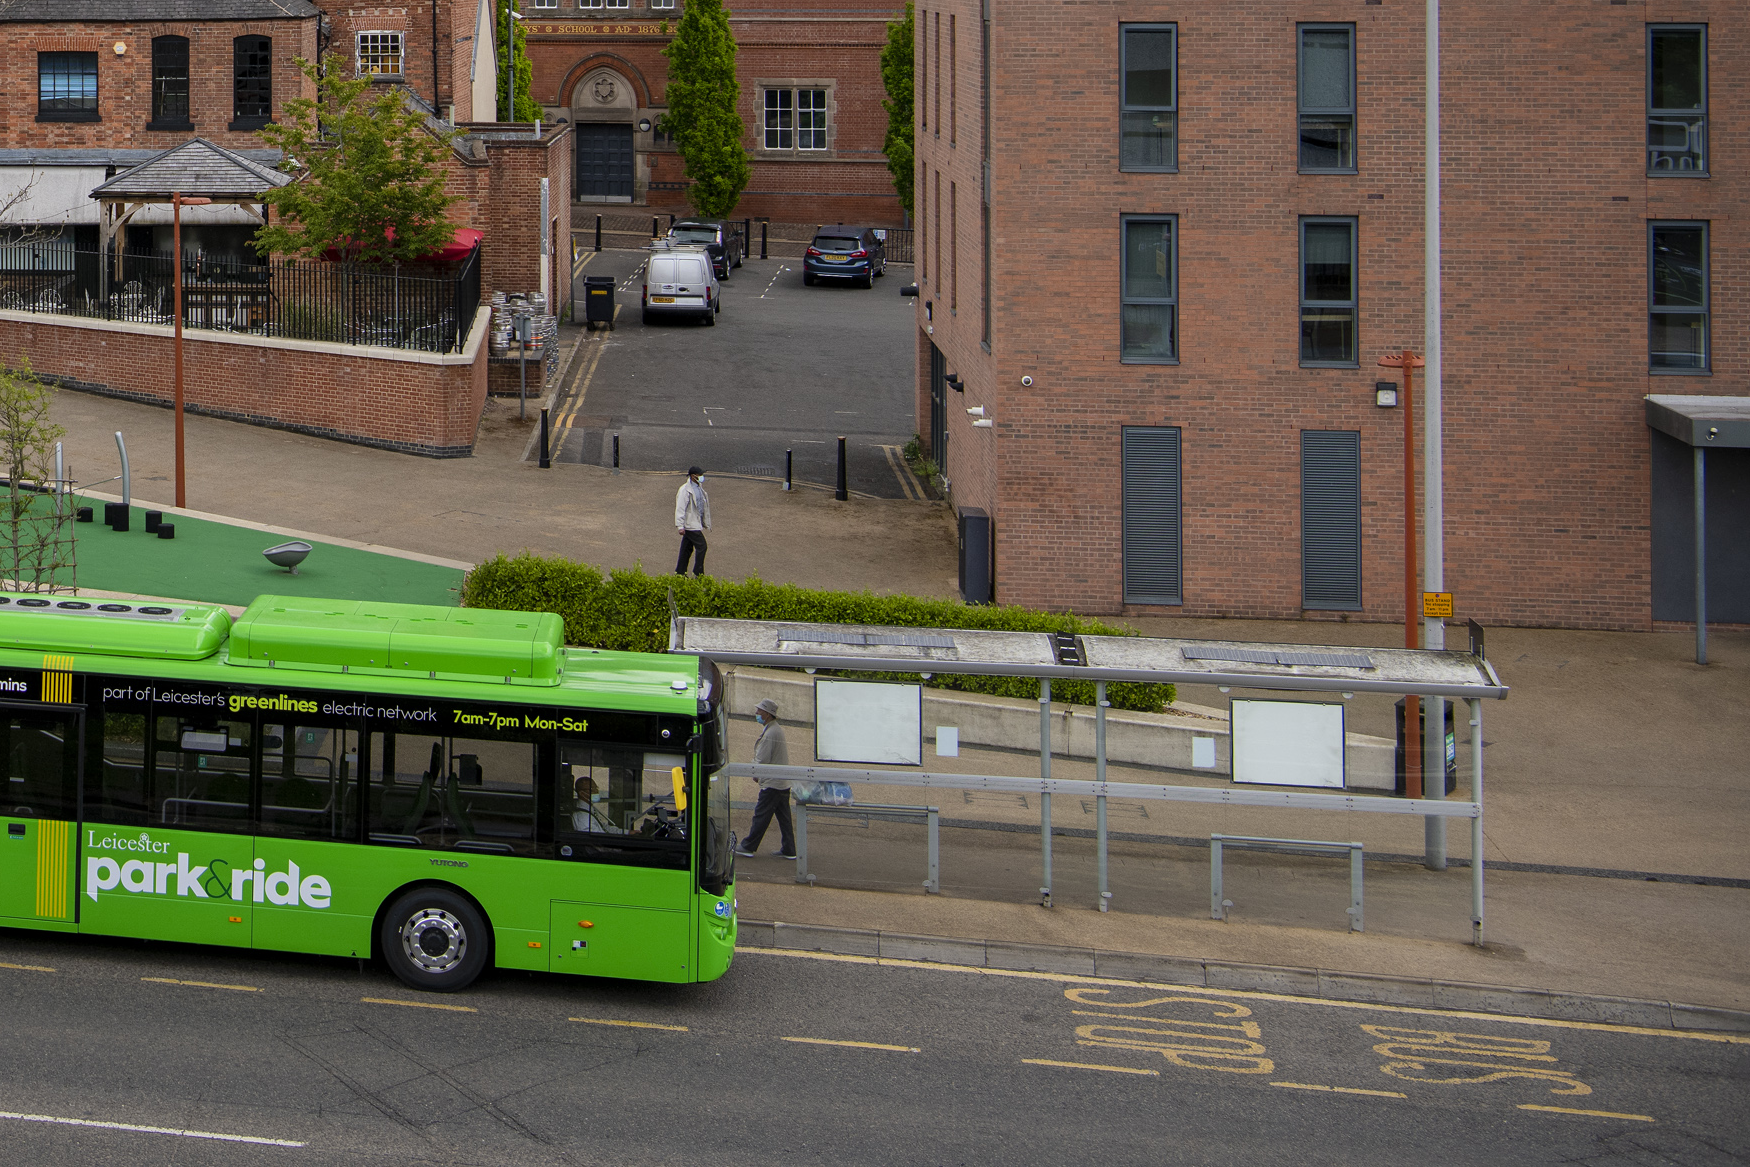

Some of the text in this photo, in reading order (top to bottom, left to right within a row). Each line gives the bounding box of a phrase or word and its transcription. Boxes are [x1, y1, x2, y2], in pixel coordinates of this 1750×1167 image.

[558, 25, 598, 34] SCHOOL
[638, 25, 661, 34] 1876
[102, 685, 437, 722] part of Leicester's greenlines electric network
[453, 709, 589, 732] 7am-7pm Mon-Sat
[88, 829, 170, 854] Leicester
[429, 858, 469, 868] YUTONG
[1063, 987, 1275, 1076] STOP
[1359, 1023, 1593, 1097] BUS
